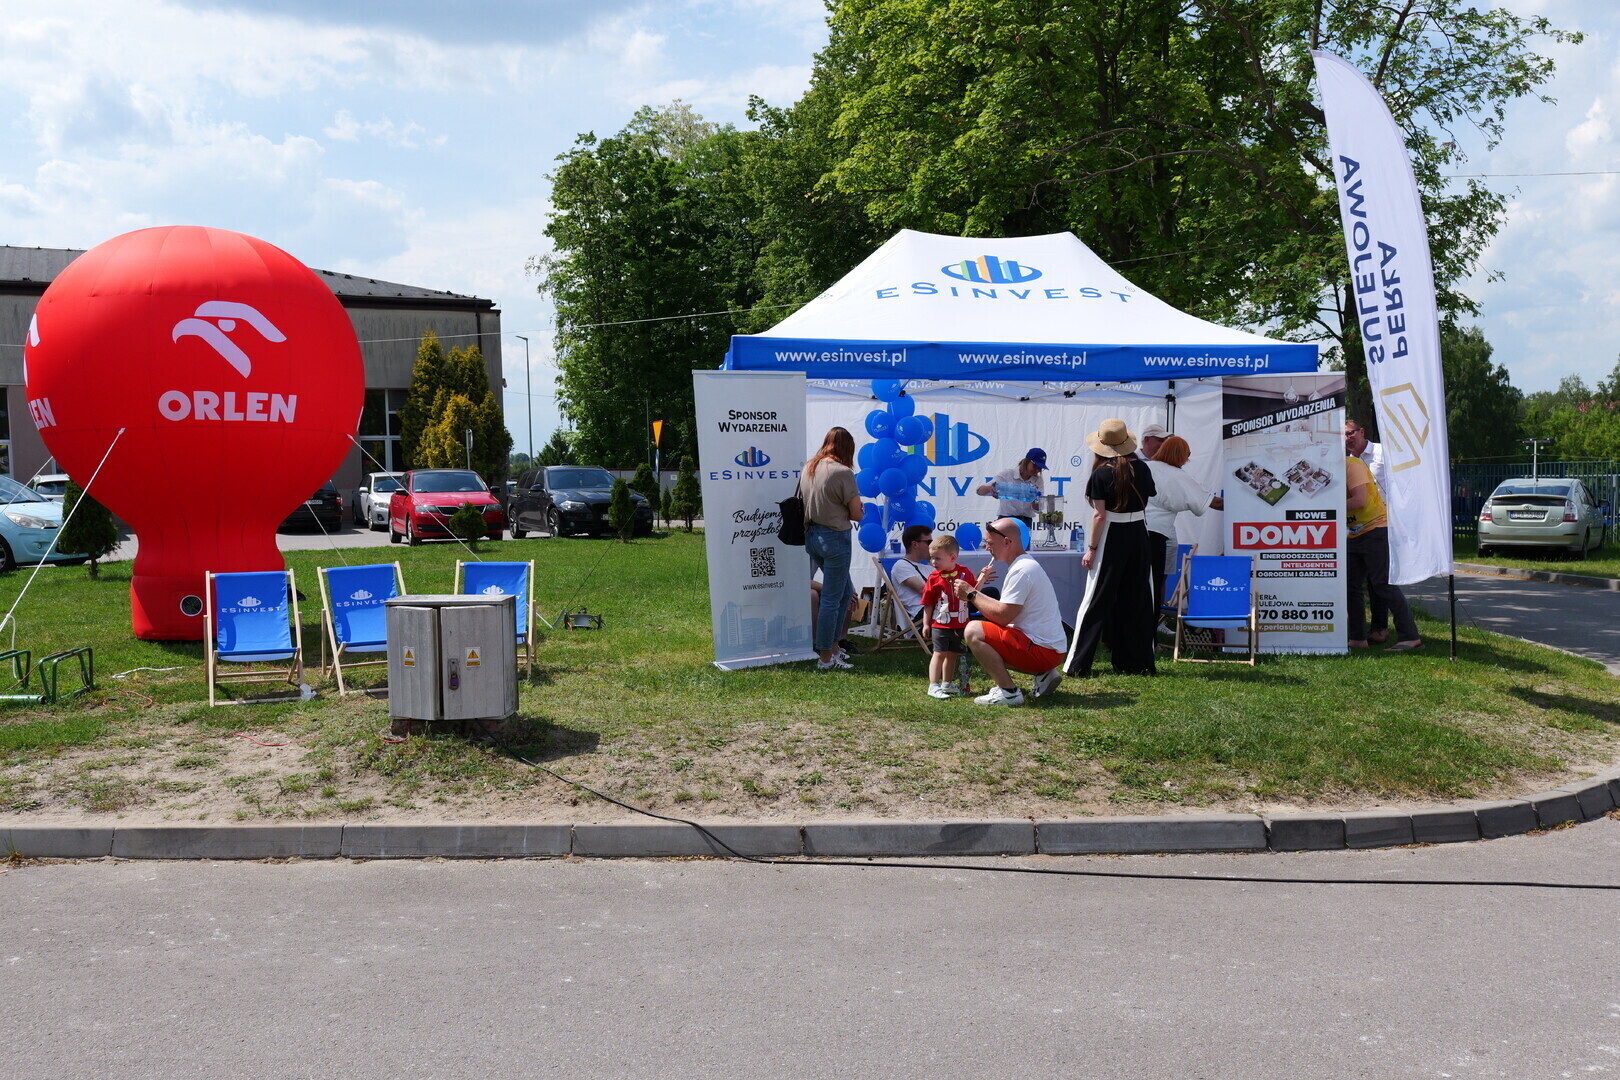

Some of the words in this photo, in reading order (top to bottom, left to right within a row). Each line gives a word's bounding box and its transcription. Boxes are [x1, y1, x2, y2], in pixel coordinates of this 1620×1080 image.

[876, 282, 1132, 303] ESINVEST
[775, 348, 907, 366] www.esinvest.pl
[958, 351, 1087, 369] www.esinvest.pl
[1144, 353, 1269, 371] www.esinvest.pl
[158, 390, 298, 423] ORLEN
[728, 409, 777, 420] SPONSOR
[1231, 415, 1274, 436] SPONSOR
[1276, 397, 1336, 423] WYDARZENIA
[718, 422, 788, 433] WYDARZENIA
[710, 470, 800, 480] ESINVEST
[1295, 511, 1327, 519] NOWE
[731, 522, 782, 544] przyszłoś
[1240, 525, 1330, 546] DOMY
[742, 580, 785, 591] www.esinvest.pl
[222, 606, 281, 614] ESINVEST
[336, 599, 386, 608] ESINVES
[1281, 610, 1309, 620] 880
[1311, 610, 1334, 620] 110
